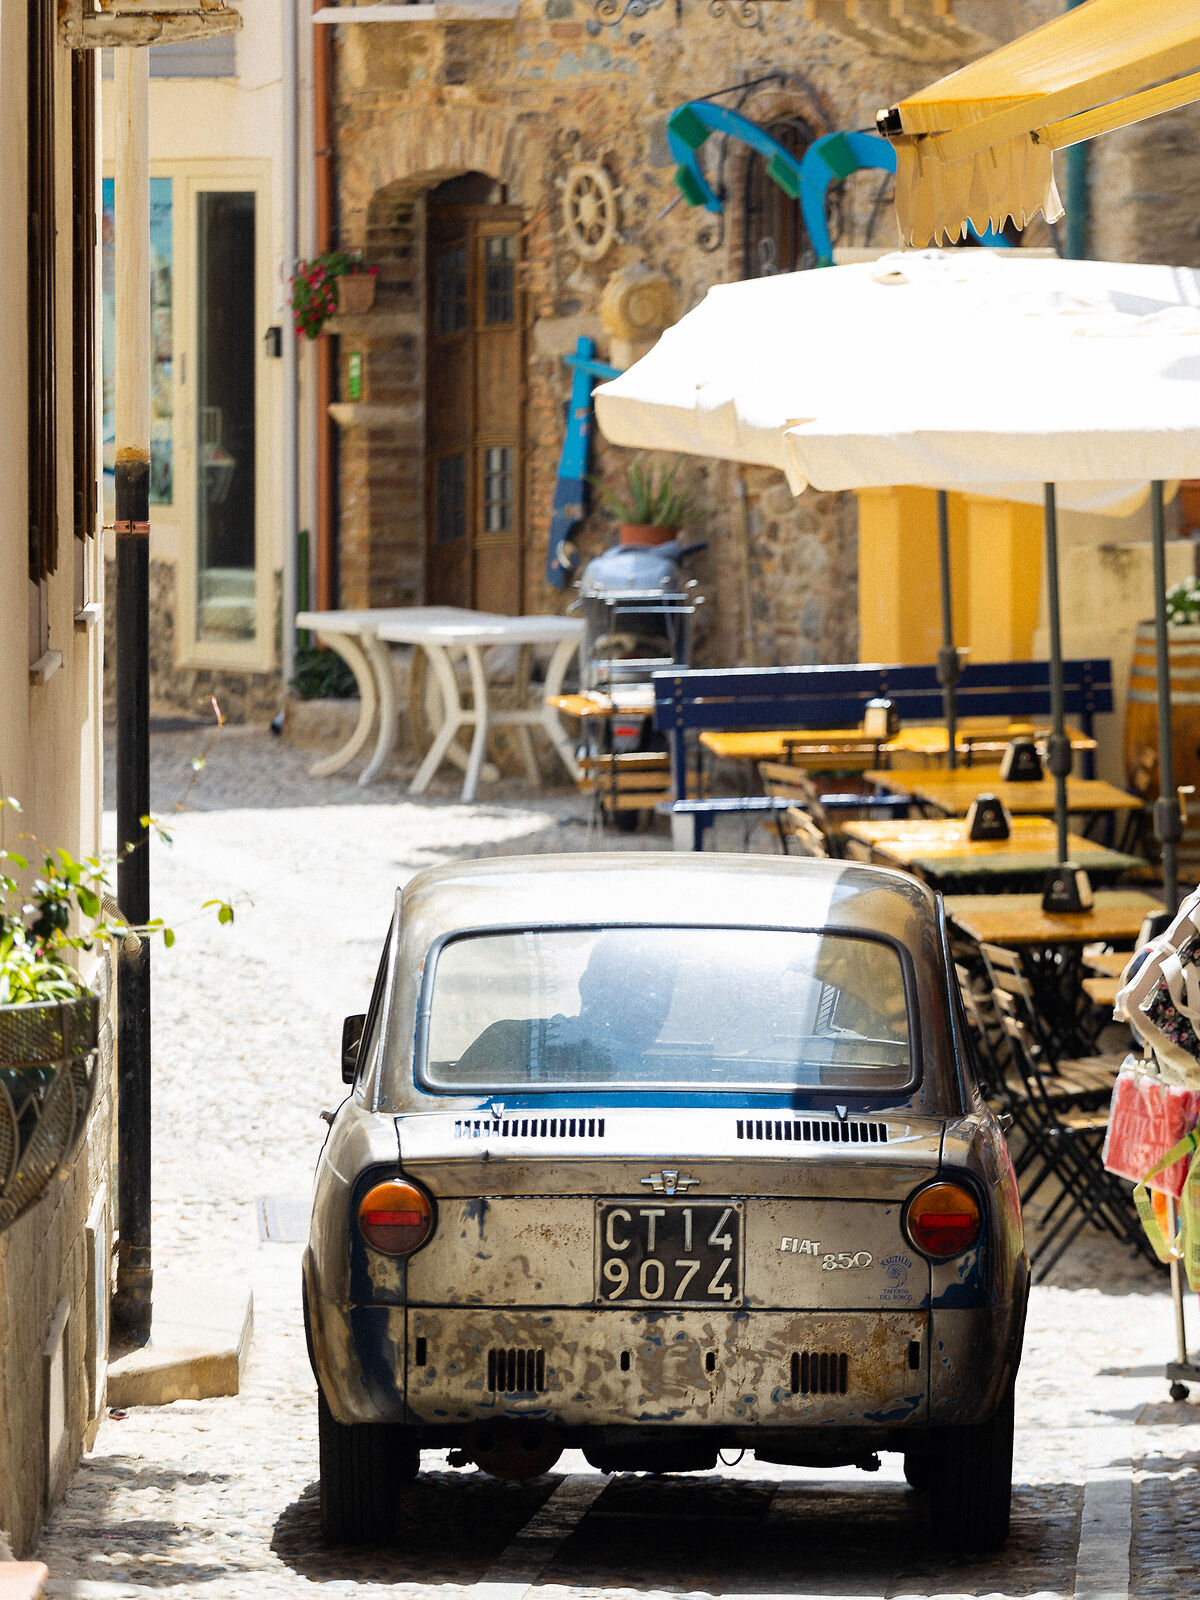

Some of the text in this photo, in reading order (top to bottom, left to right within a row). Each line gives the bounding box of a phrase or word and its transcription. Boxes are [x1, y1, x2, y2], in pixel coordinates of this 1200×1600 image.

[780, 1236, 874, 1271] FIAT 850
[603, 1257, 733, 1300] 9074
